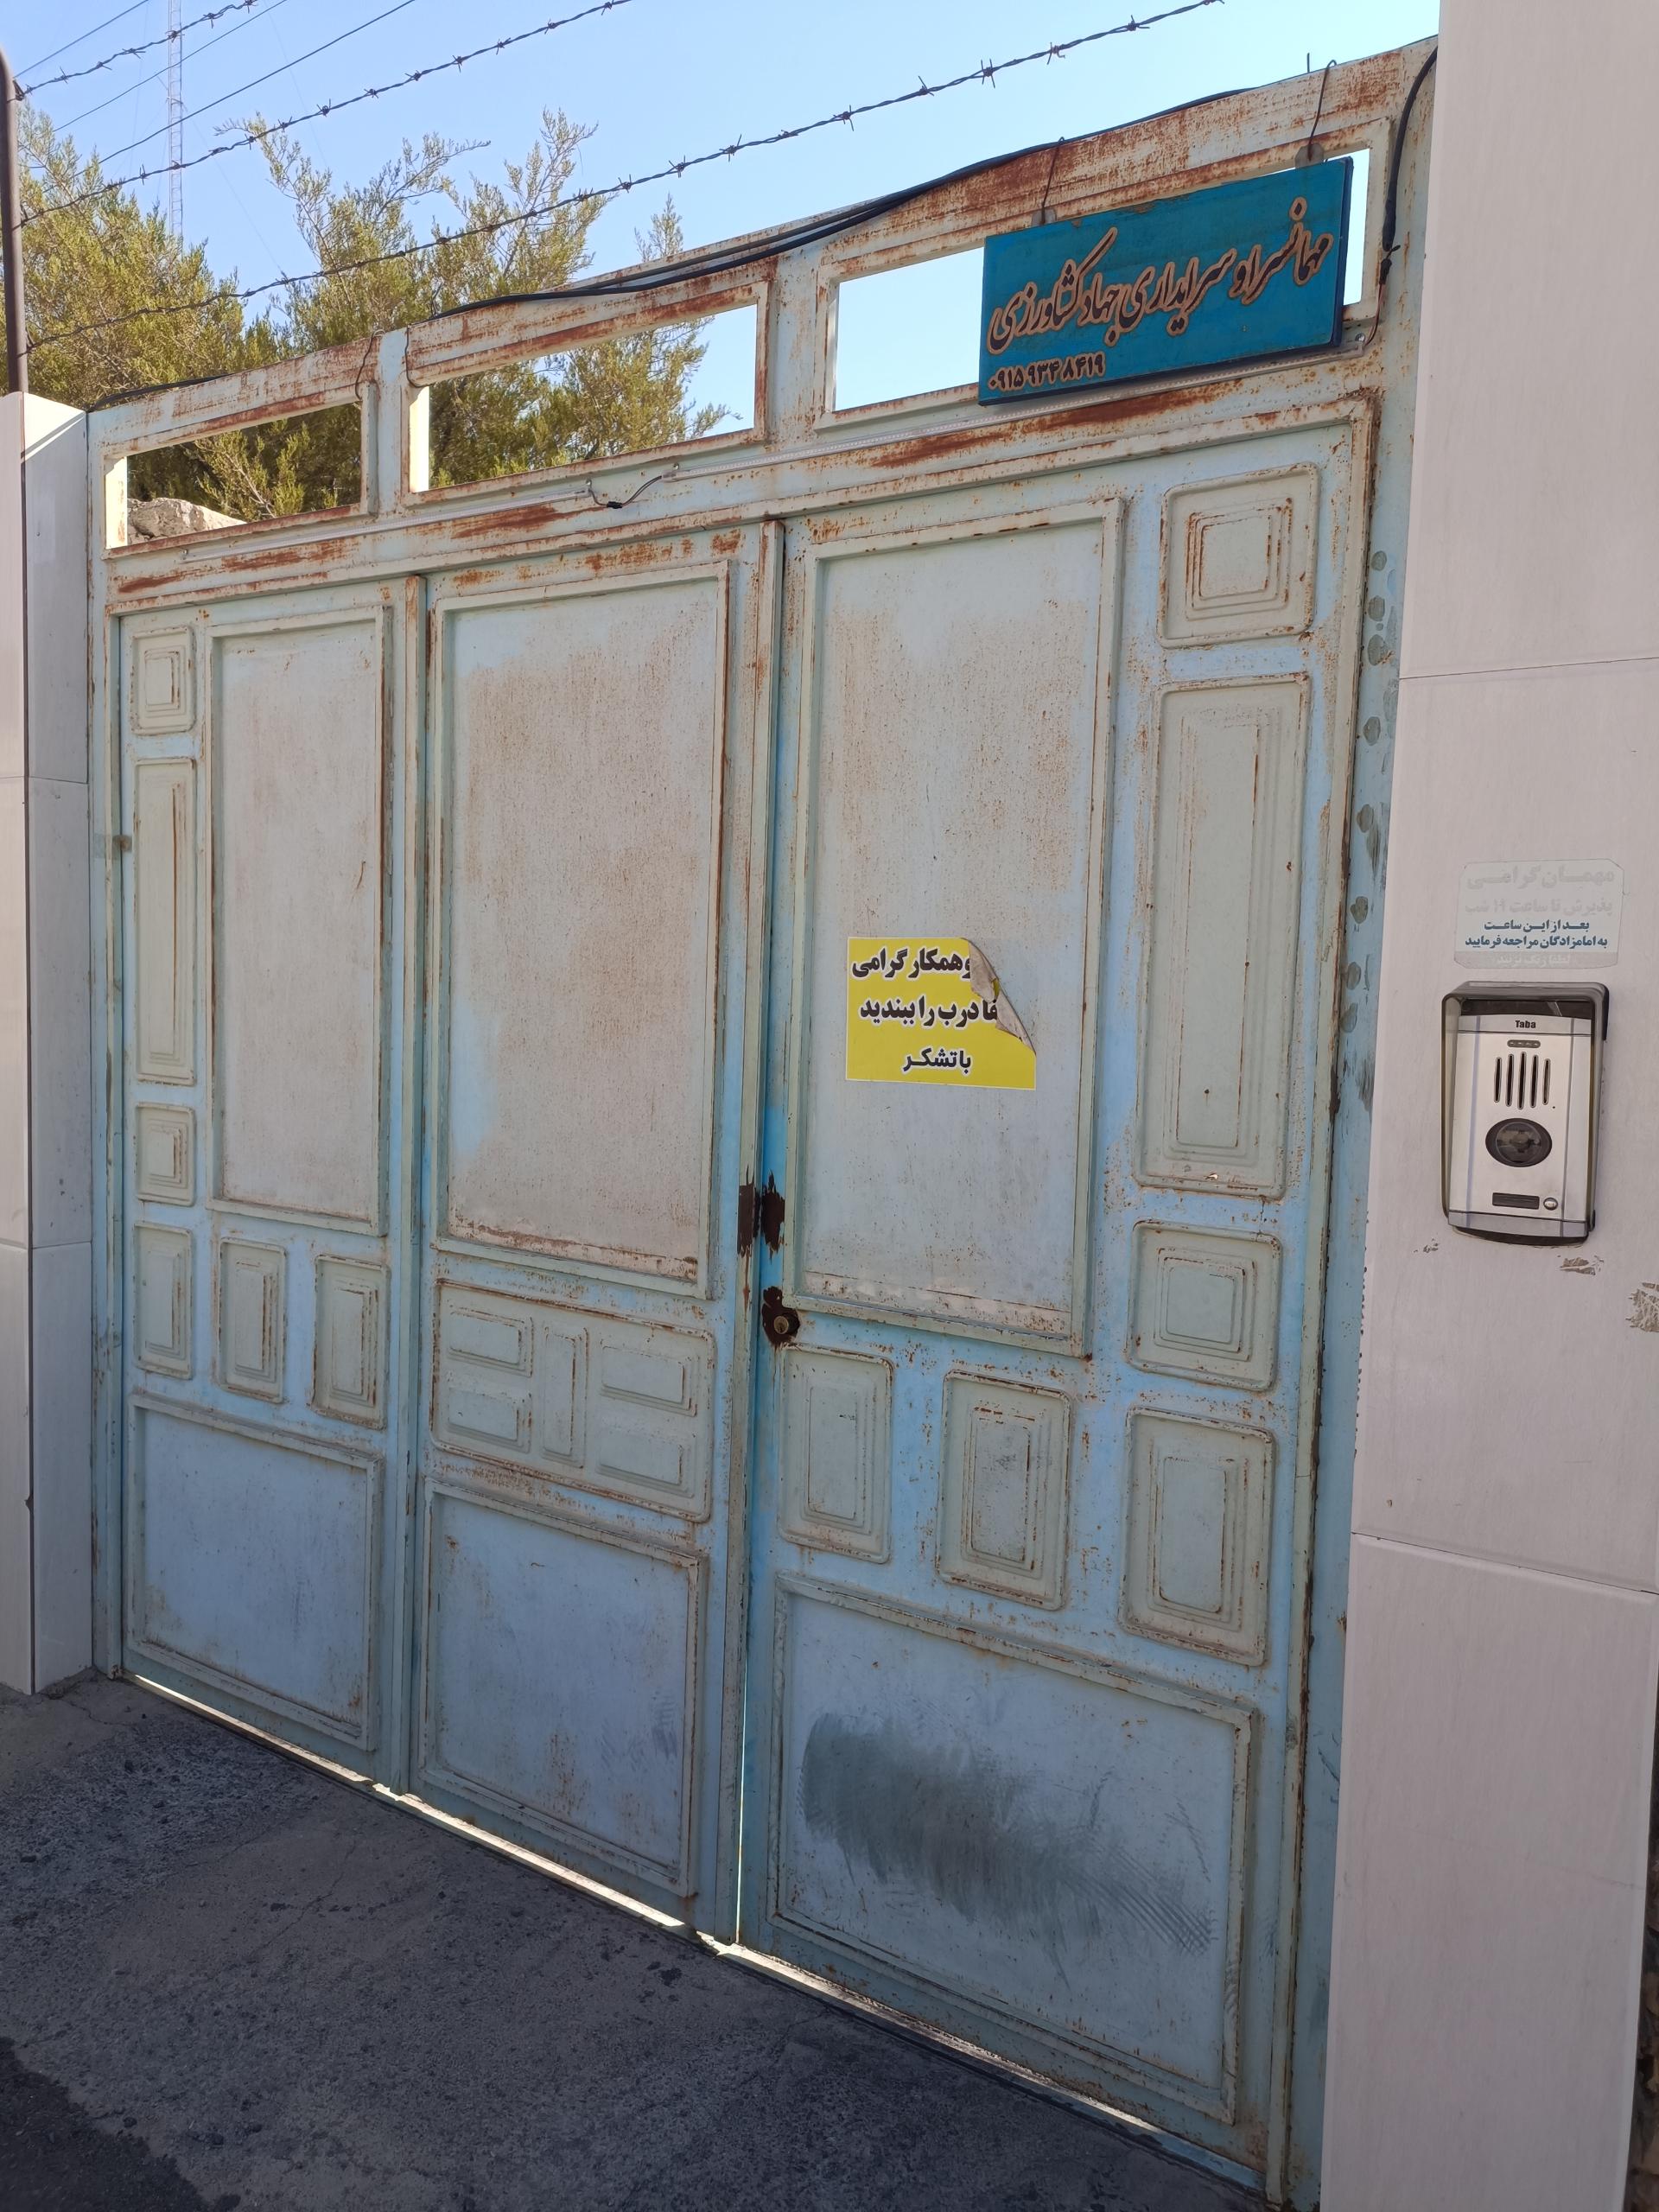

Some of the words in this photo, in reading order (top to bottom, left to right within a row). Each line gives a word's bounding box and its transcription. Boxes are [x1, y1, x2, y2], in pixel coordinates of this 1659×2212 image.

[987, 226, 1118, 354] کشاورزی
[1117, 248, 1237, 336] سرایداری
[1077, 272, 1122, 346] جهاد
[1484, 919, 1522, 931] ساعت
[1523, 919, 1550, 932] این
[1551, 919, 1561, 933] از
[1563, 921, 1590, 932] بعد
[1465, 934, 1502, 950] فرمایید
[1503, 935, 1539, 949] مراجعه
[1598, 936, 1608, 949] به
[852, 948, 907, 978] گرامی
[908, 948, 963, 978] همکار
[860, 999, 916, 1025] ببندید
[918, 995, 935, 1027] را
[938, 1001, 979, 1027] درب
[1515, 1020, 1536, 1029] Taba
[903, 1048, 957, 1072] تشکر
[959, 1050, 971, 1074] با
